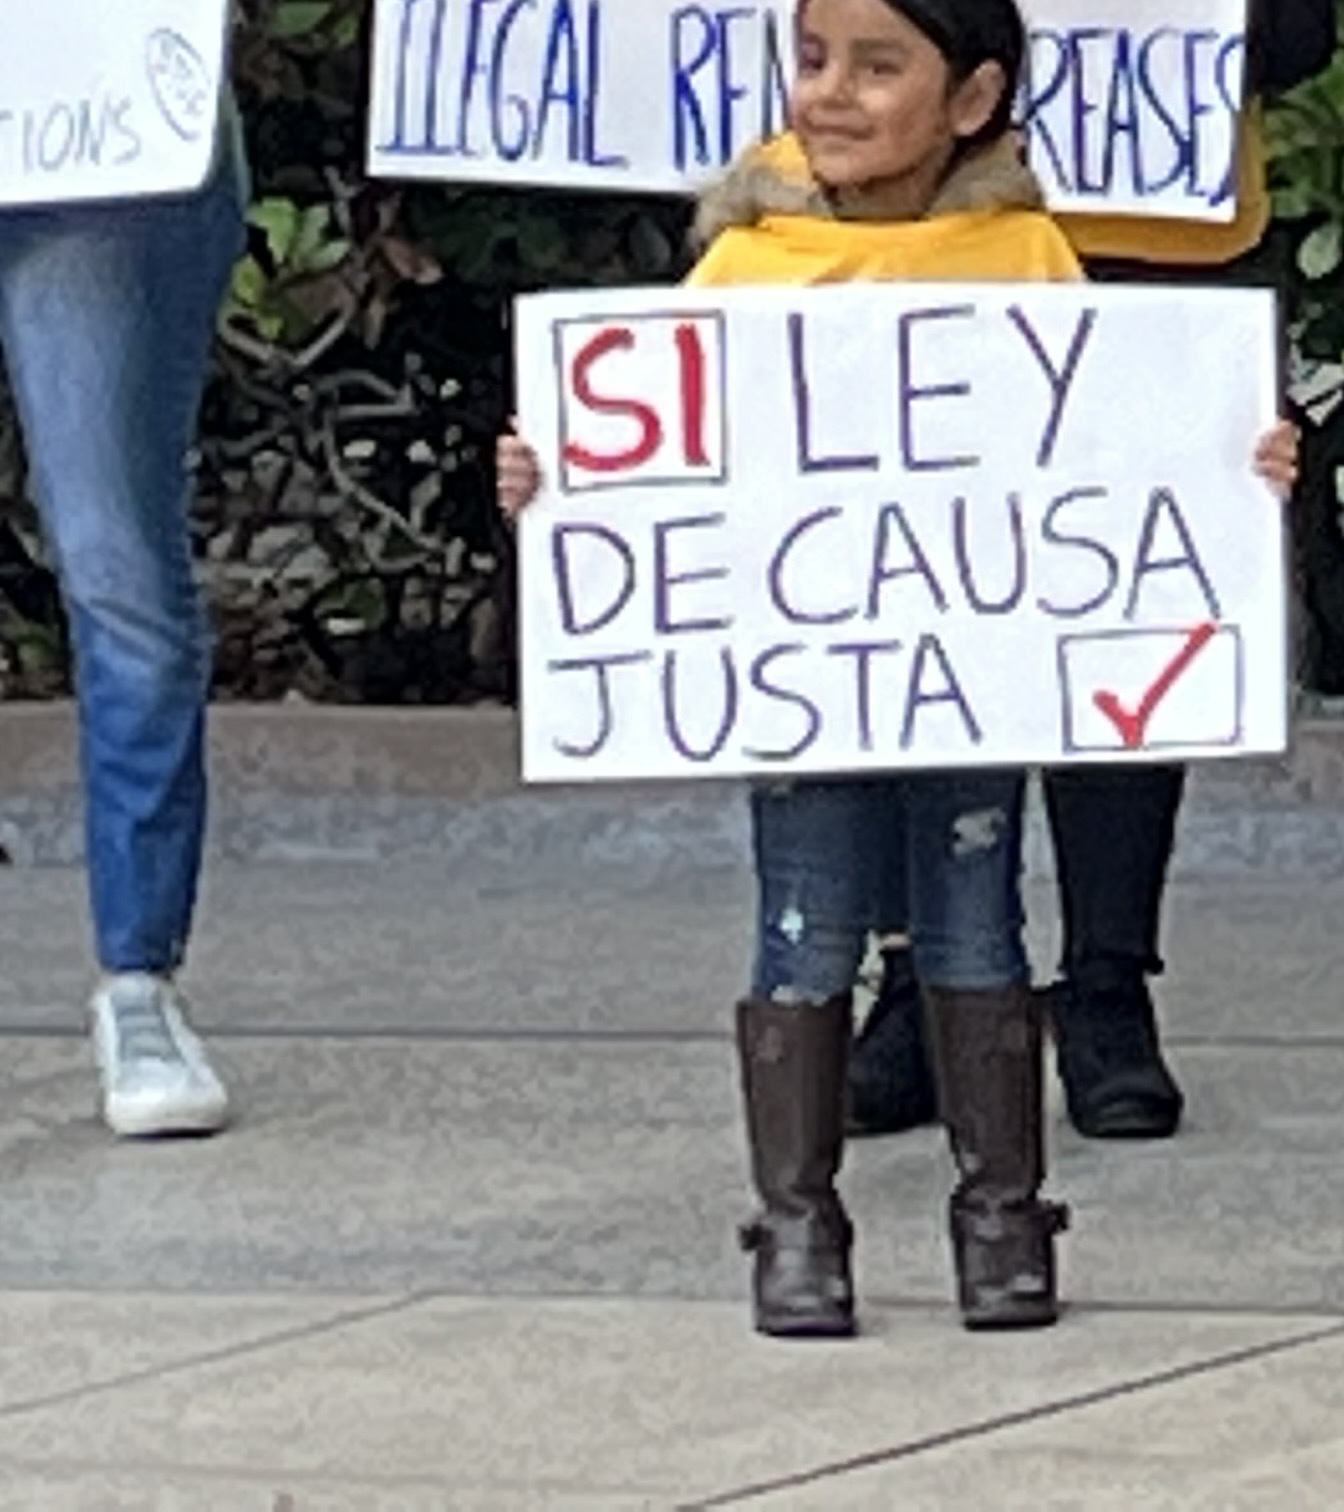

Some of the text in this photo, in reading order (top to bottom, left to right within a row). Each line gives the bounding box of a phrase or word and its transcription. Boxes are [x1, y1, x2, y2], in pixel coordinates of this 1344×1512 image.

[562, 304, 1098, 473] SI LEY
[552, 488, 1223, 637] DE CAUSA
[548, 631, 984, 763] JUSTA
